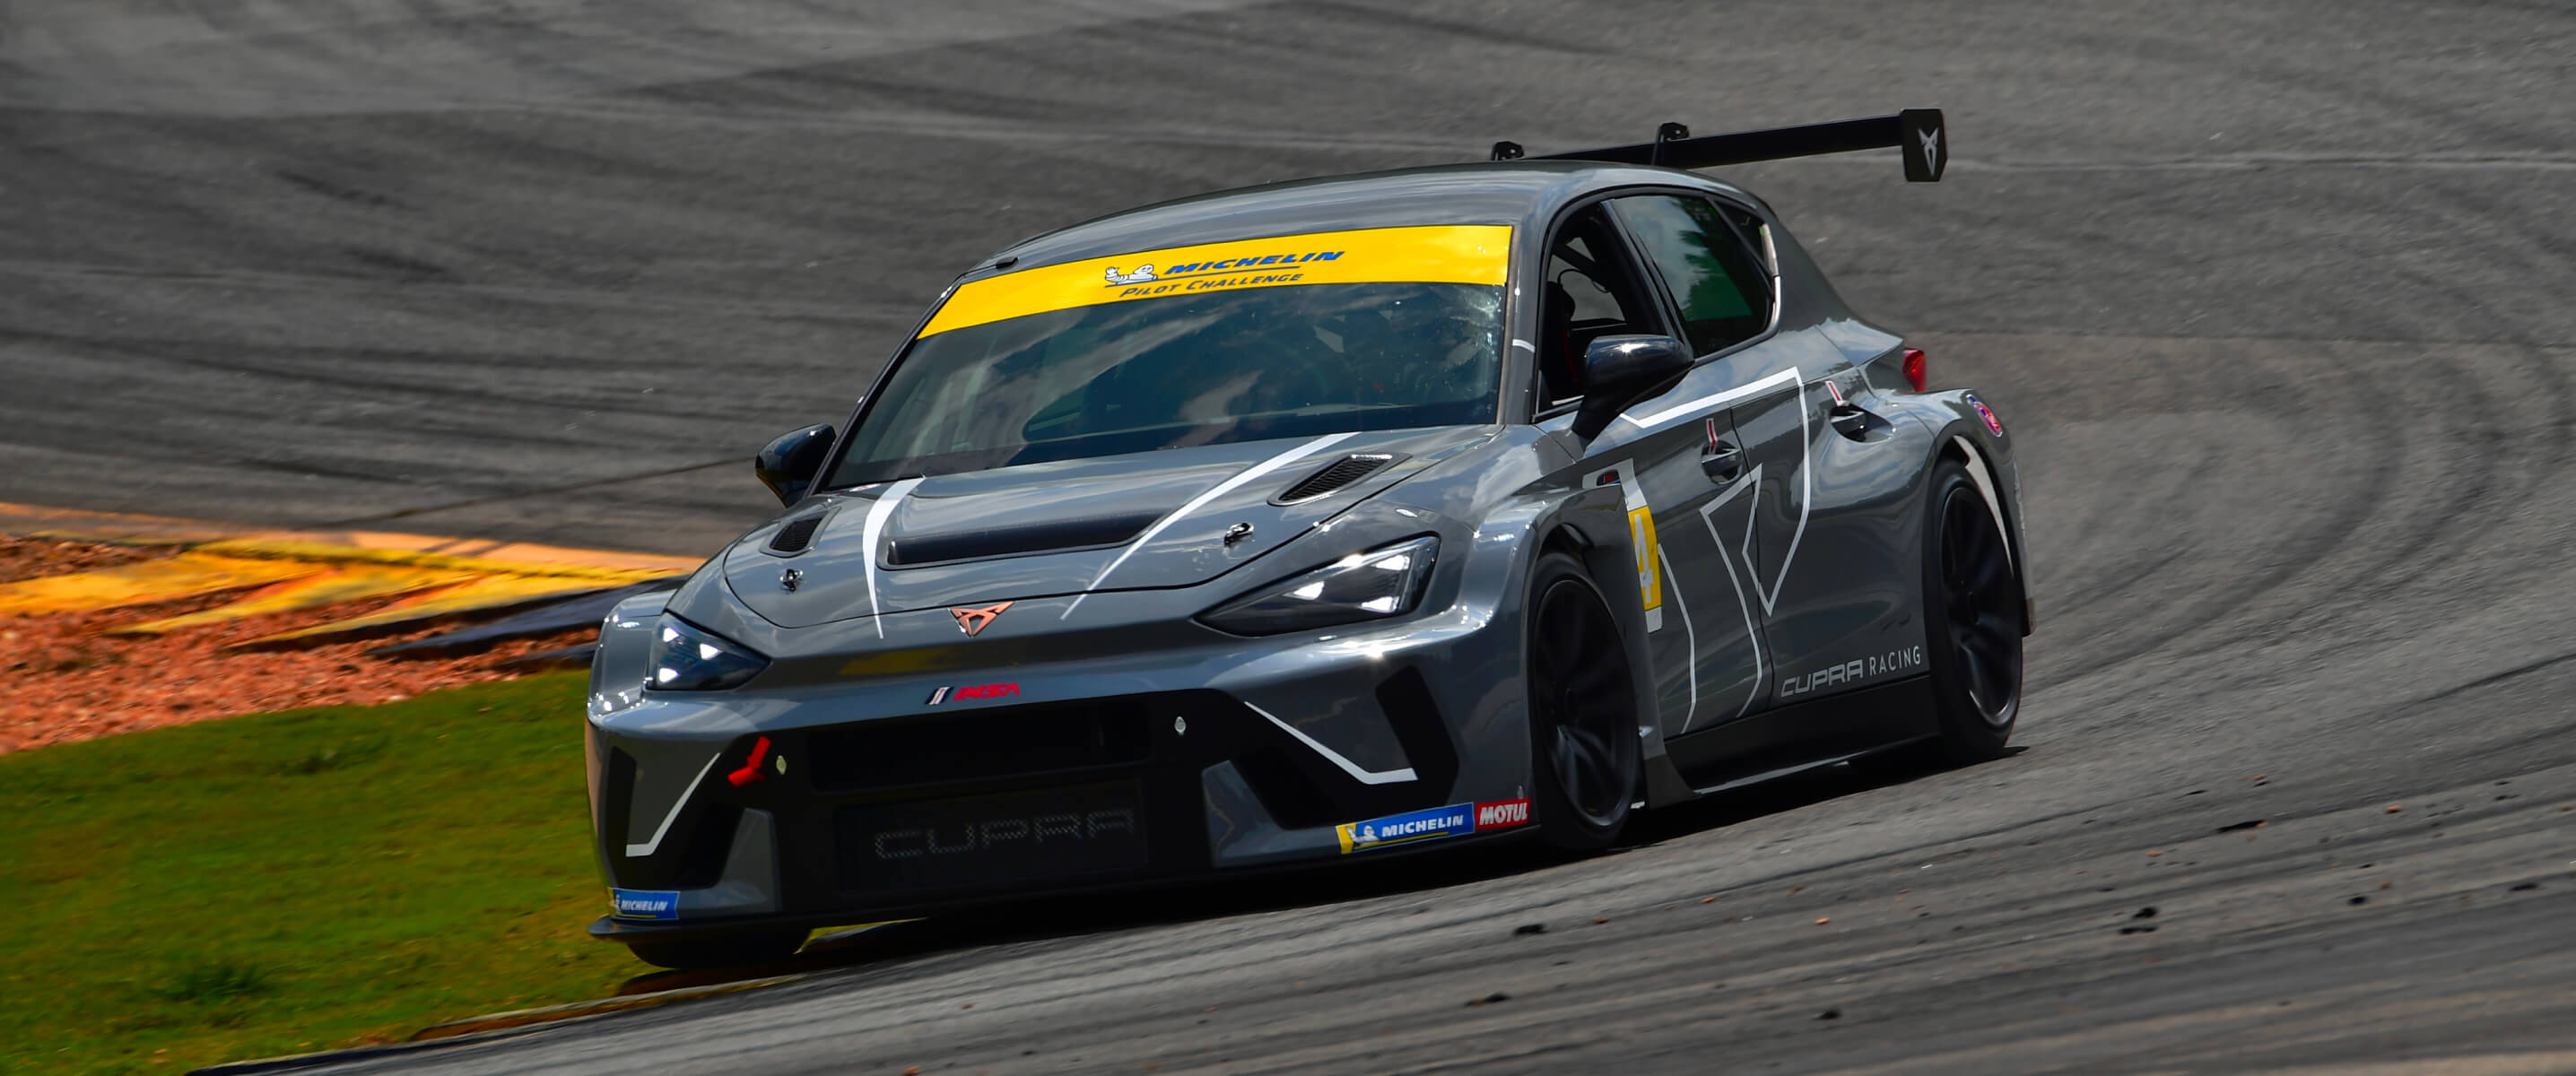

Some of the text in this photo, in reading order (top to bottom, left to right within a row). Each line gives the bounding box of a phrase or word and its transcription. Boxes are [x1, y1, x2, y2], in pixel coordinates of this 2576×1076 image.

[1164, 251, 1345, 274] MICHELIN
[1119, 273, 1304, 298] PILOT CHALLENGE
[1780, 646, 1921, 698] CUPRA RACING
[953, 682, 1020, 702] IMSA
[1381, 814, 1465, 837] MICHELIN
[1479, 802, 1528, 826] MOTUL
[875, 809, 1135, 860] CUPRA
[620, 899, 668, 912] MICHELIN
